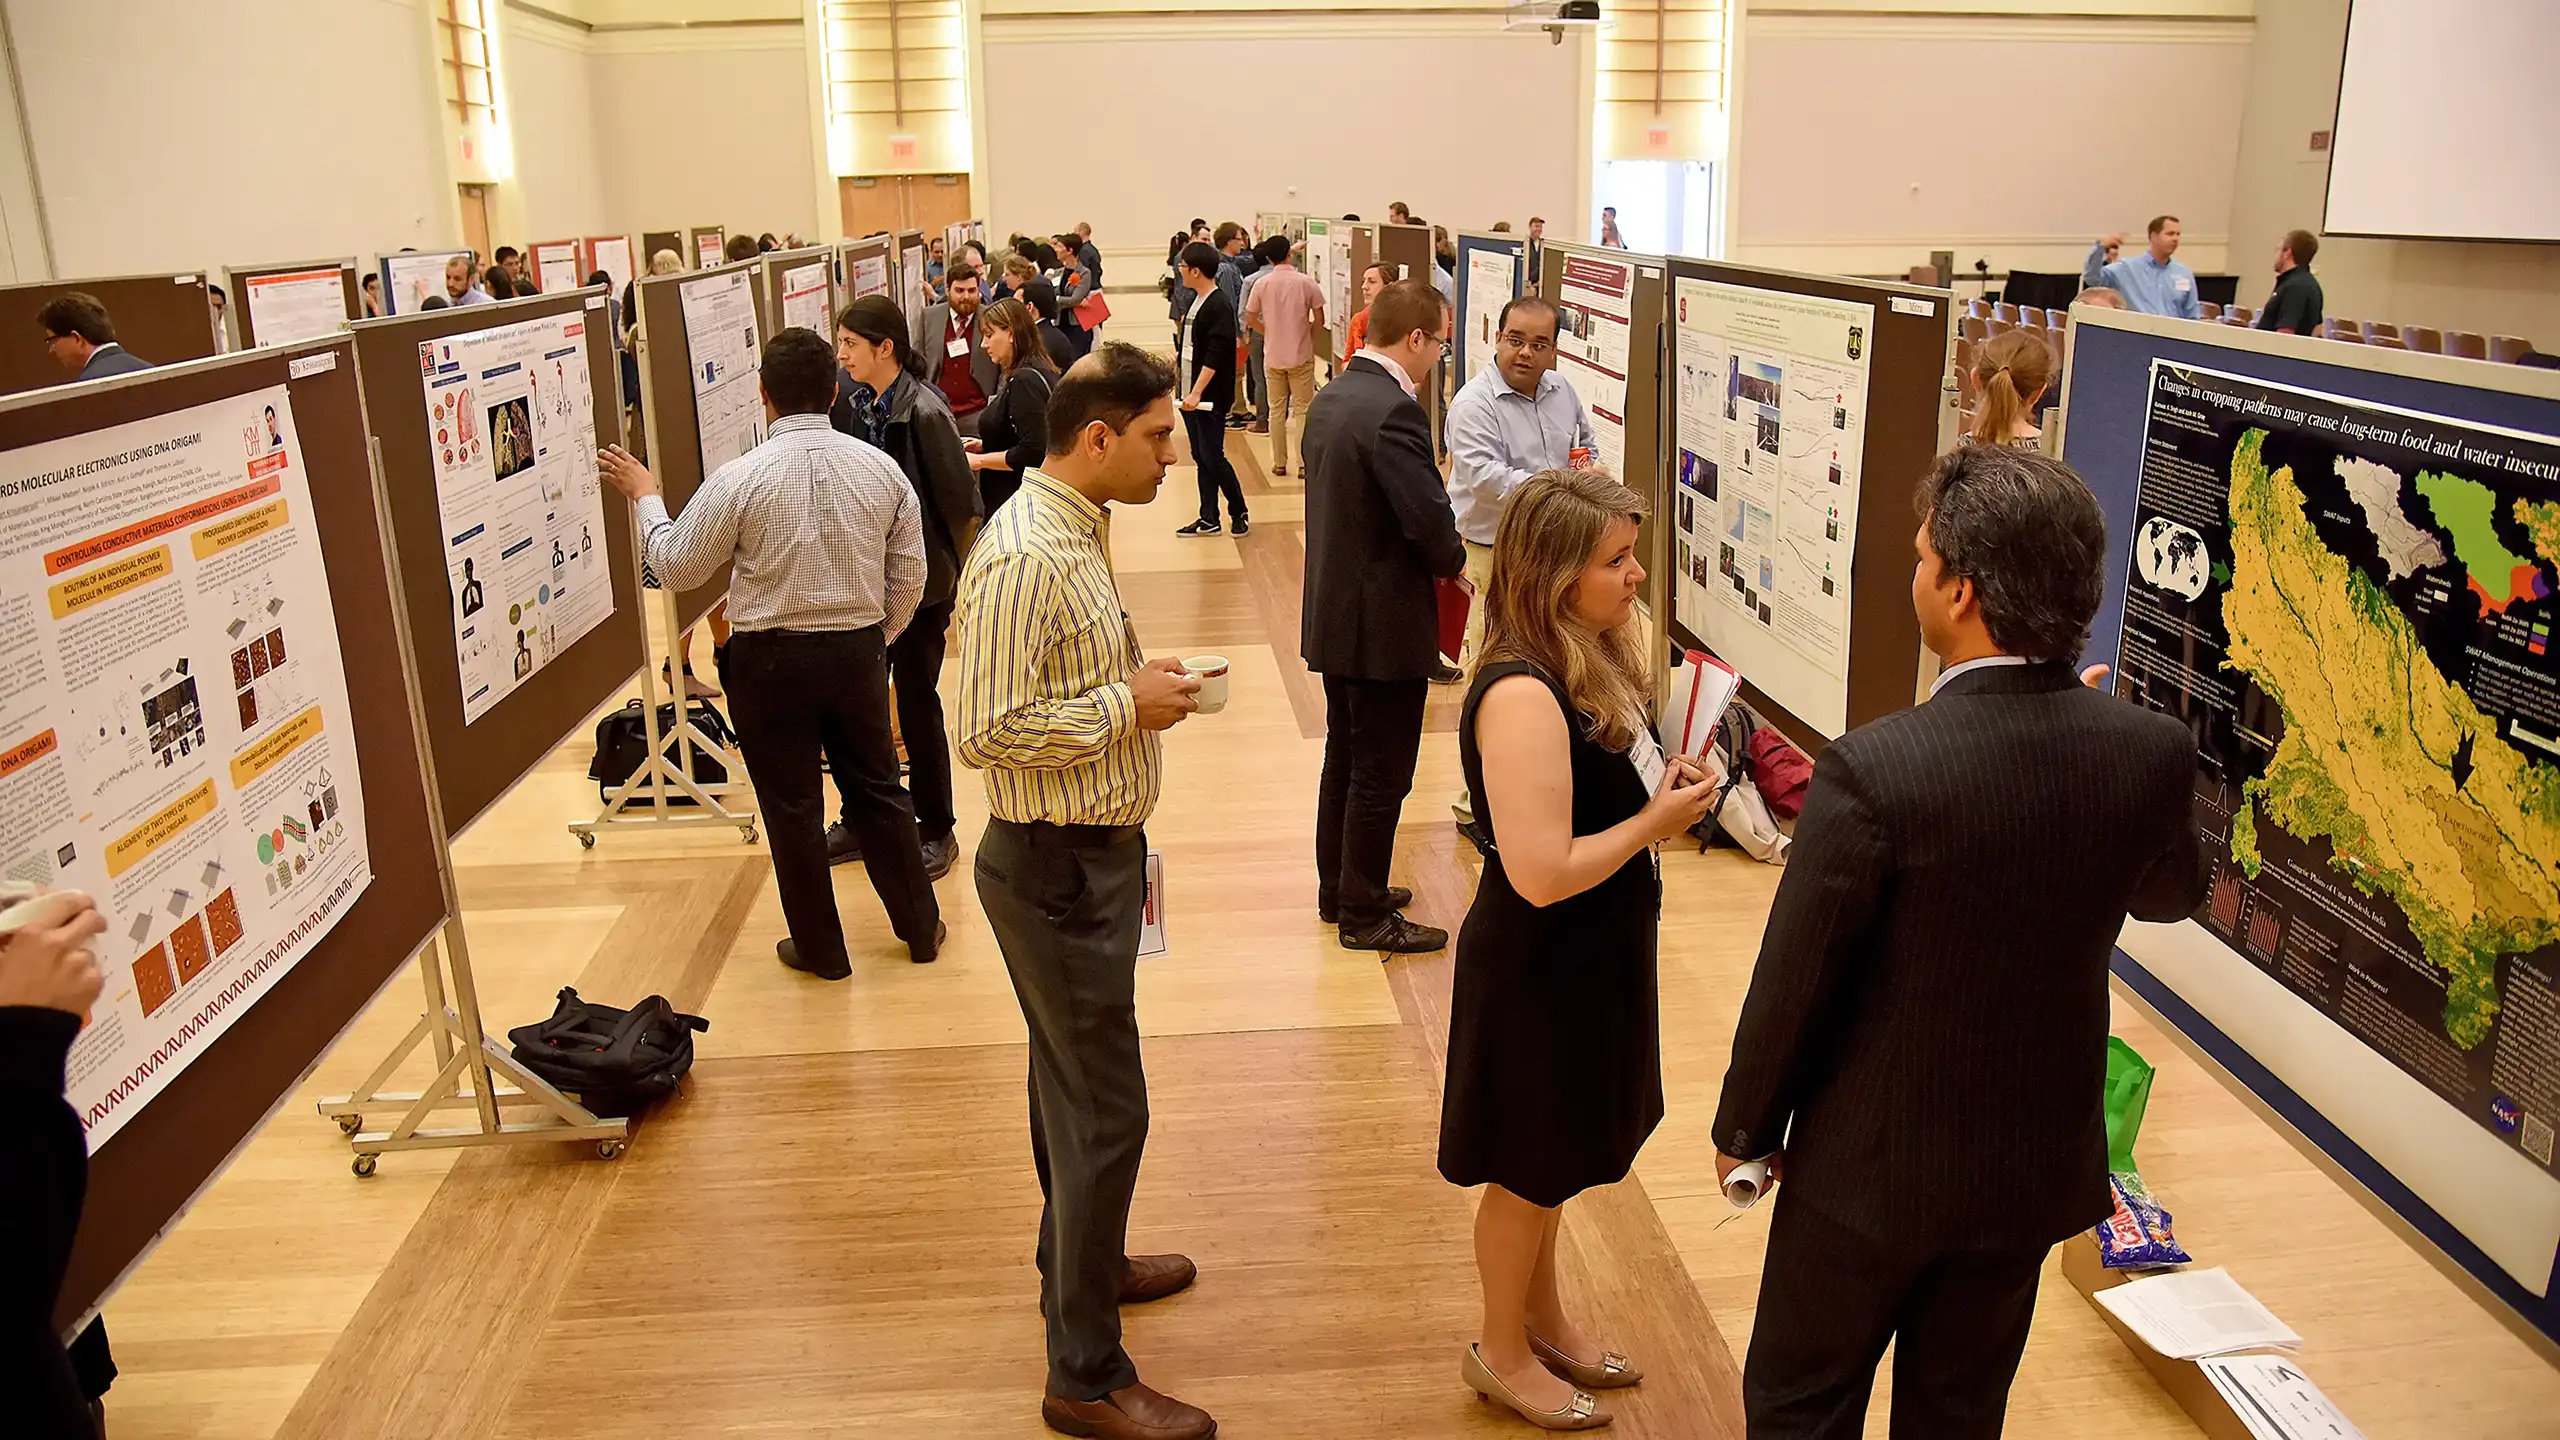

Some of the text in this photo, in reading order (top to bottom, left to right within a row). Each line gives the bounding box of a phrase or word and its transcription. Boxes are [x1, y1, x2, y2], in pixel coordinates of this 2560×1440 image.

[2158, 374, 2190, 398] Changes
[2192, 382, 2200, 399] in
[2202, 389, 2243, 412] cropping
[2242, 398, 2282, 418] patterns
[2283, 408, 2306, 426] may
[2307, 412, 2338, 431] cause
[2340, 416, 2398, 445] long-term
[2400, 428, 2434, 453] food
[2433, 438, 2462, 459] and
[2463, 446, 2503, 468] water
[21, 466, 75, 492] MOLECULAR
[77, 452, 128, 477] ELECTRONICS
[130, 445, 153, 463] USING
[154, 440, 171, 456] DNA
[171, 432, 202, 450] ORIGAMI
[56, 542, 102, 567] CONTROLLING
[102, 528, 142, 552] CONDUCTIVE
[142, 517, 174, 535] MATERIALS
[174, 501, 220, 524] CONFORMATIONS
[220, 496, 237, 508] USING
[237, 491, 248, 502] DNA
[202, 522, 234, 539] PROGRAMMED
[217, 520, 268, 546] POLYMER CONFORMATIONS
[2323, 509, 2351, 525] SWAT Inputs
[64, 550, 161, 595] ROUTING OF AN INDIVIDUAL POLYMER
[66, 562, 164, 608] MOLECULE IN PREDESIGNED PATTERNS
[2426, 574, 2451, 588] Watersheds
[2465, 645, 2556, 685] SWAT Management Operations
[2479, 664, 2489, 673] Two
[1, 736, 52, 771] DNA ORIGAMI
[240, 744, 268, 767] Immobilization
[143, 825, 150, 835] OF
[150, 817, 164, 831] TWO
[163, 808, 178, 822] TYPES
[178, 802, 184, 812] OF
[185, 786, 208, 808] POLYMERS
[145, 814, 189, 848] ON DNA ORIGAMI
[2443, 811, 2494, 845] Experimental
[2457, 835, 2474, 851] Area
[2286, 858, 2310, 880] Gangetic
[2310, 870, 2326, 887] Plains
[2326, 879, 2335, 893] of
[2347, 896, 2371, 920] Pradesh,
[2371, 909, 2387, 929] India
[2348, 962, 2389, 994] Work in Progress!
[2512, 956, 2522, 969] Key
[2491, 1102, 2516, 1126] NASA
